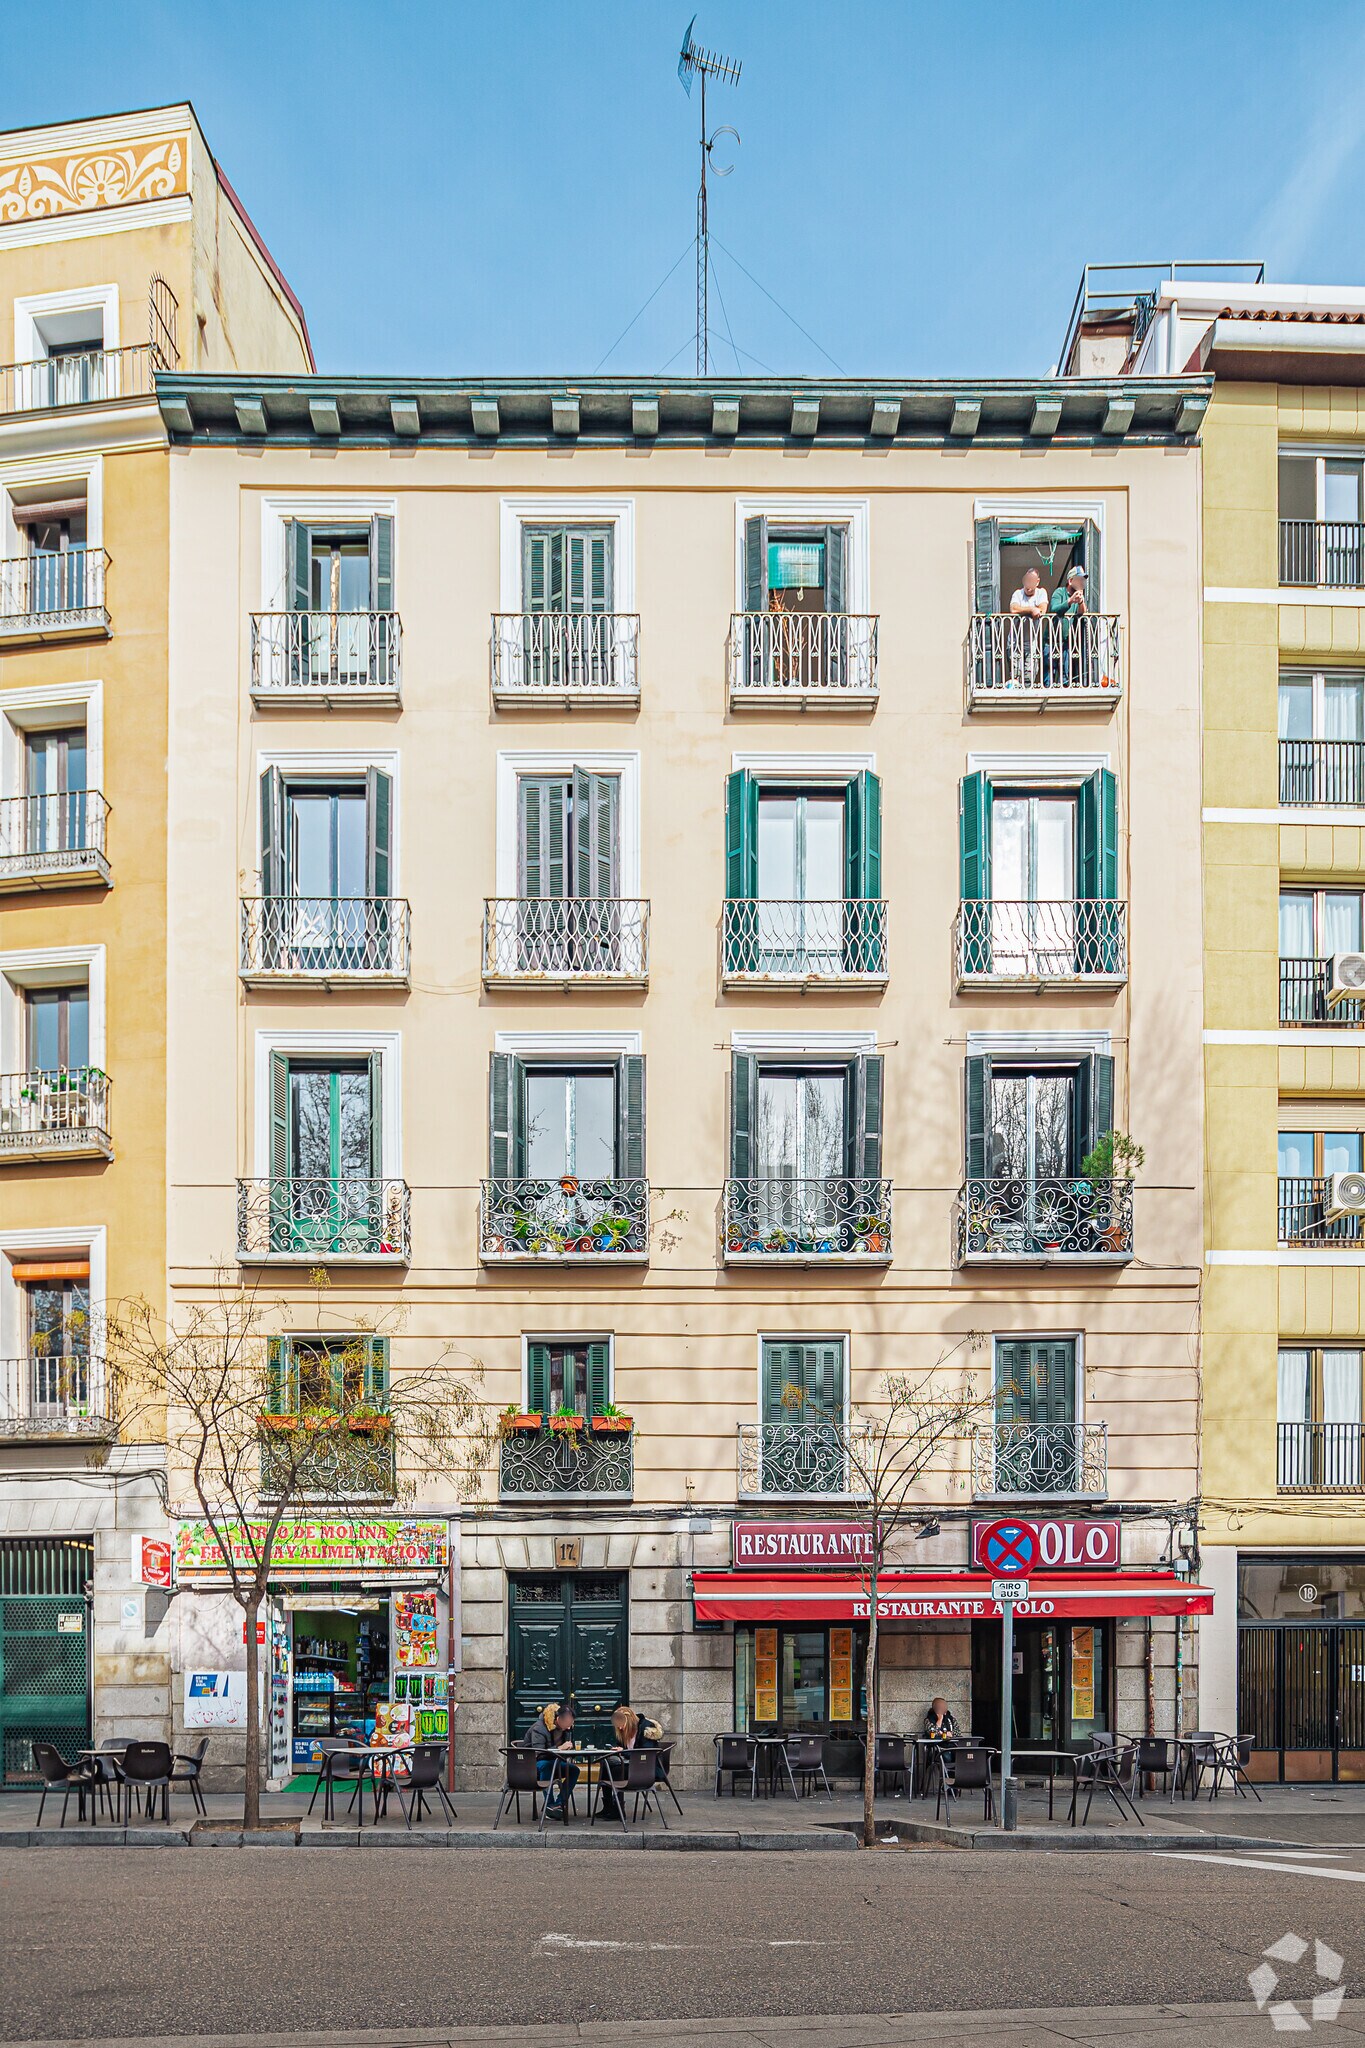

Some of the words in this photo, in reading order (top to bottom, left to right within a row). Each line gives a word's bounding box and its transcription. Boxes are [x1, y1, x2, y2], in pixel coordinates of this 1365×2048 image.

[239, 1525, 289, 1539] TIRO
[293, 1525, 316, 1539] DE
[320, 1525, 389, 1539] MOLINA
[740, 1533, 875, 1556] RESTAURANTE
[200, 1545, 284, 1559] FRTERA
[286, 1545, 297, 1559] Y
[999, 1582, 1021, 1590] GIRO
[1000, 1590, 1019, 1598] BUS
[1303, 1587, 1314, 1600] 18
